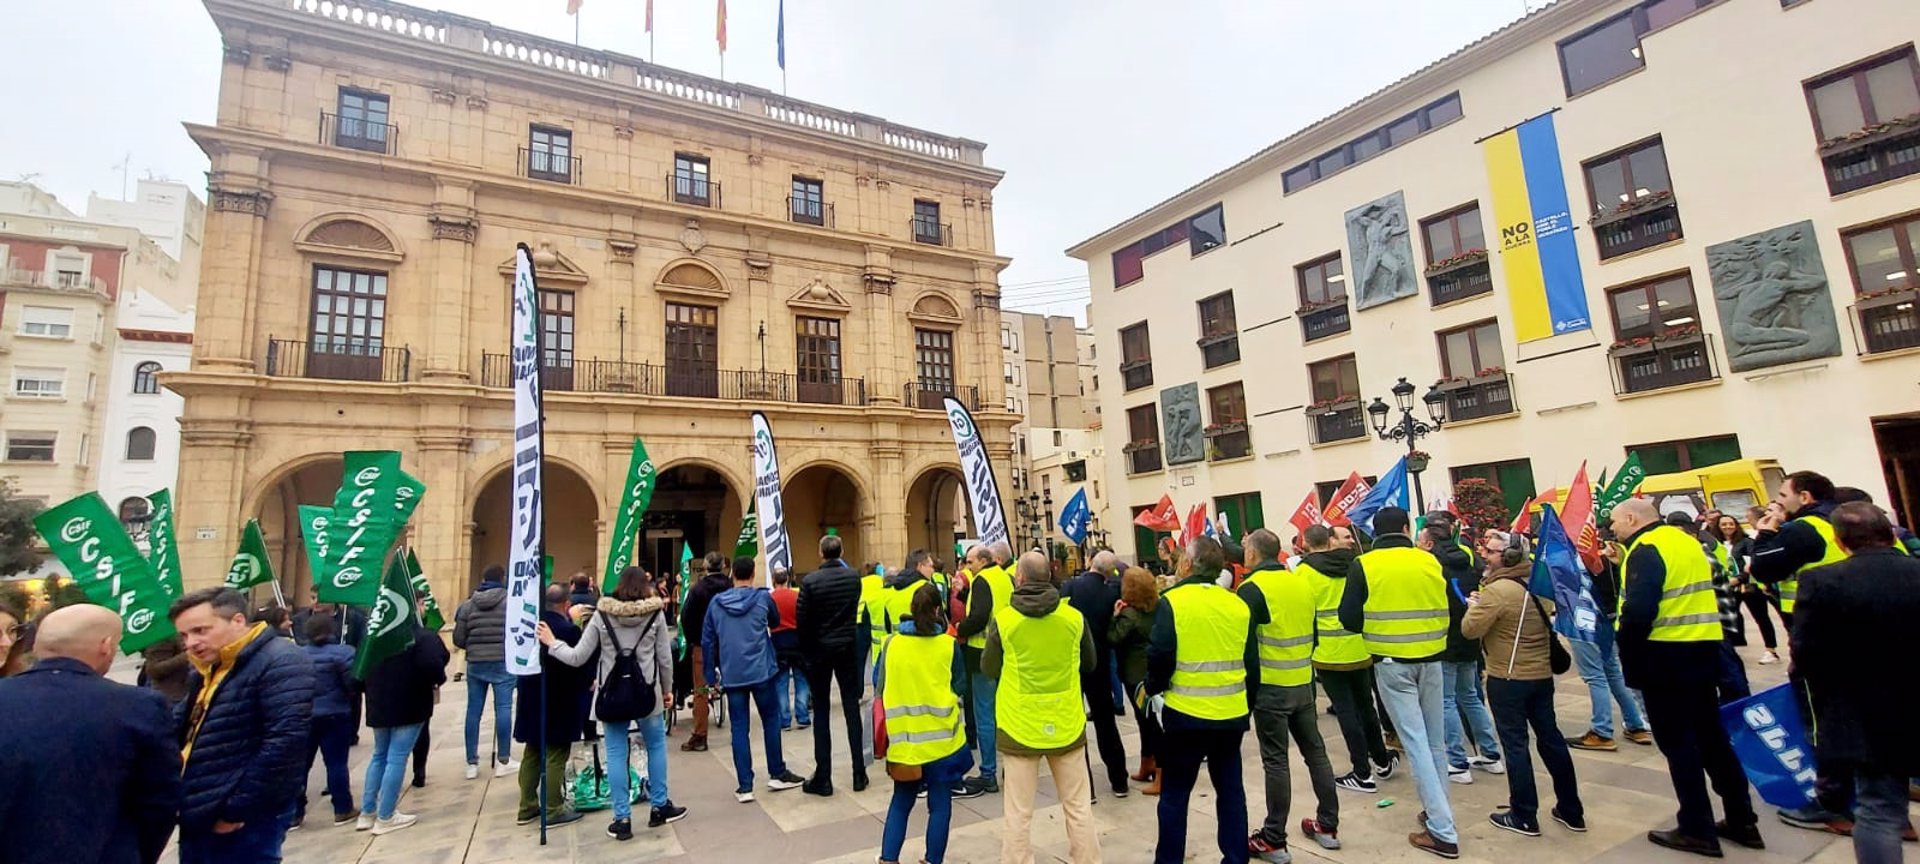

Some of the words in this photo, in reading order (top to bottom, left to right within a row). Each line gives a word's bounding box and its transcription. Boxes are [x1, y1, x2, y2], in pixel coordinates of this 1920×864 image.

[1502, 222, 1529, 239] NO
[1505, 238, 1512, 246] A
[1515, 233, 1530, 243] LA
[338, 488, 376, 566] CSIF
[617, 480, 648, 553] CSIF
[80, 537, 136, 616] CSIF
